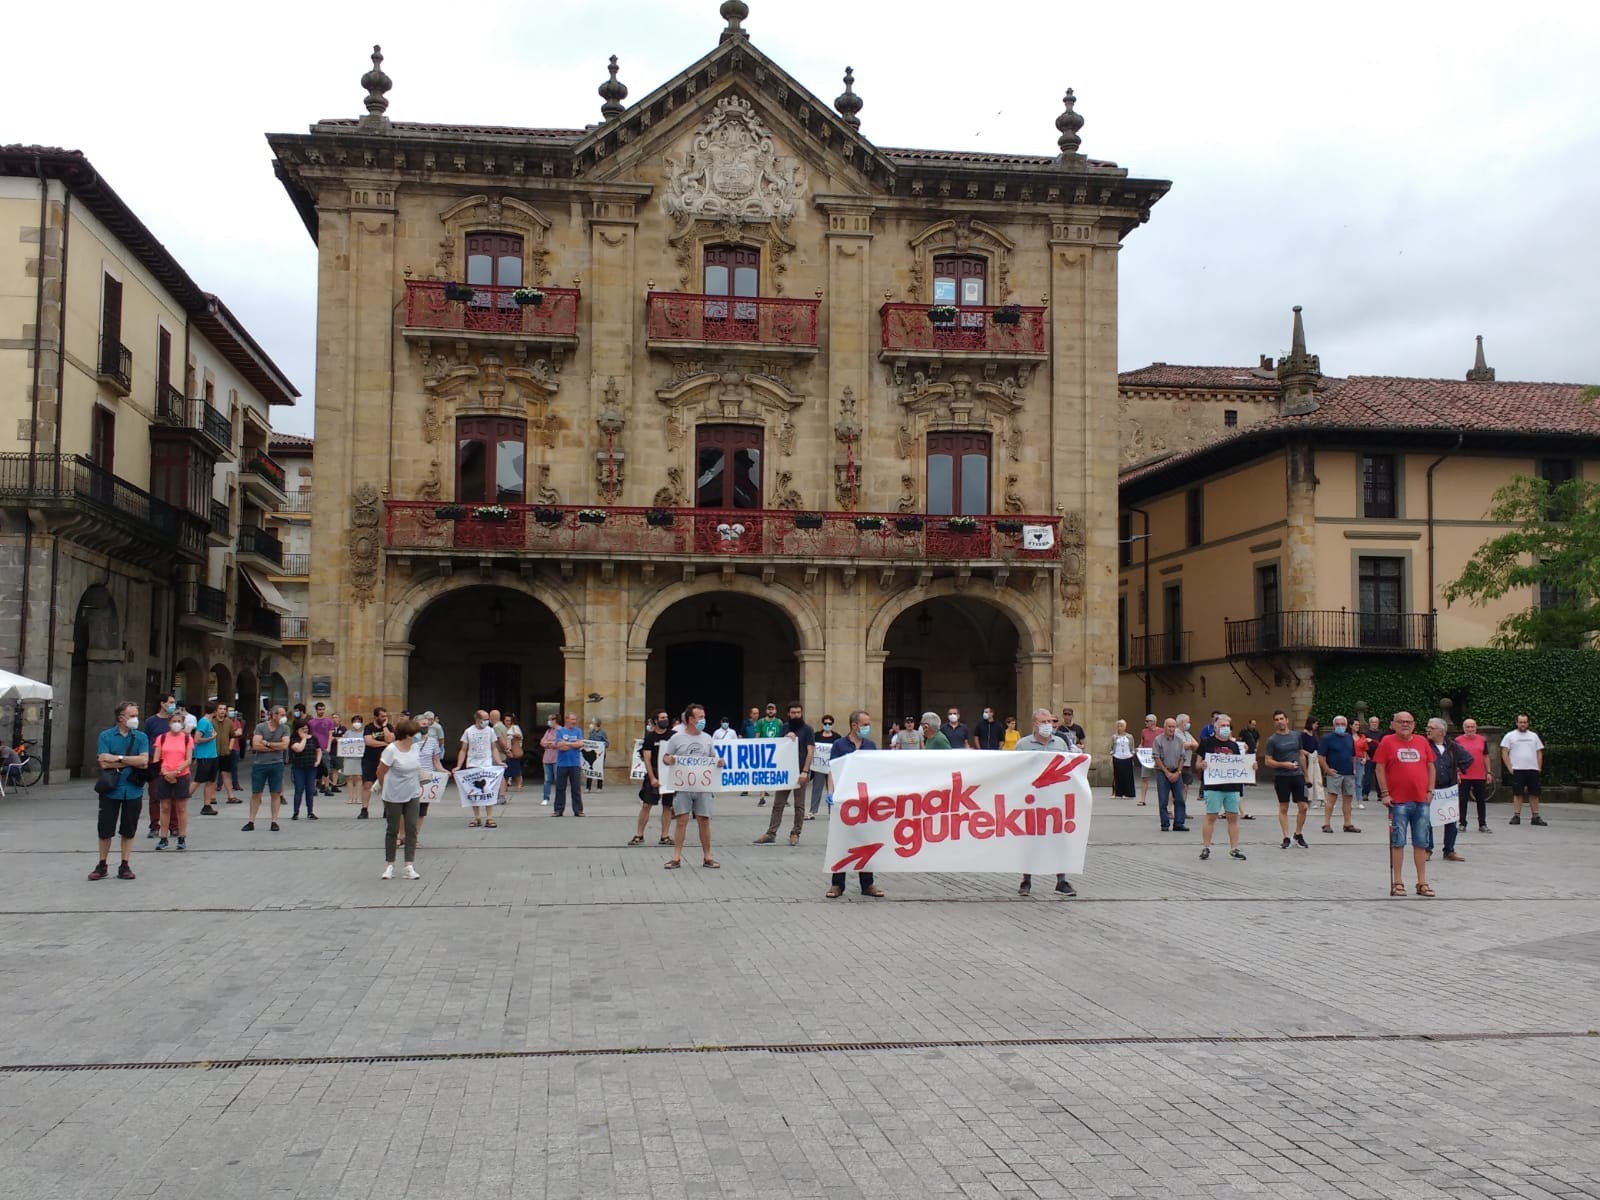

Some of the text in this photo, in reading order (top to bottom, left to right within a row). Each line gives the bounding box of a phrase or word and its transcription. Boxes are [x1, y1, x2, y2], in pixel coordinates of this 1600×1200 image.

[737, 743, 777, 769] RUIZ
[752, 770, 789, 786] GREBAN
[1208, 767, 1248, 779] KALERA
[840, 772, 980, 826] denak
[893, 793, 1075, 858] gurekin!
